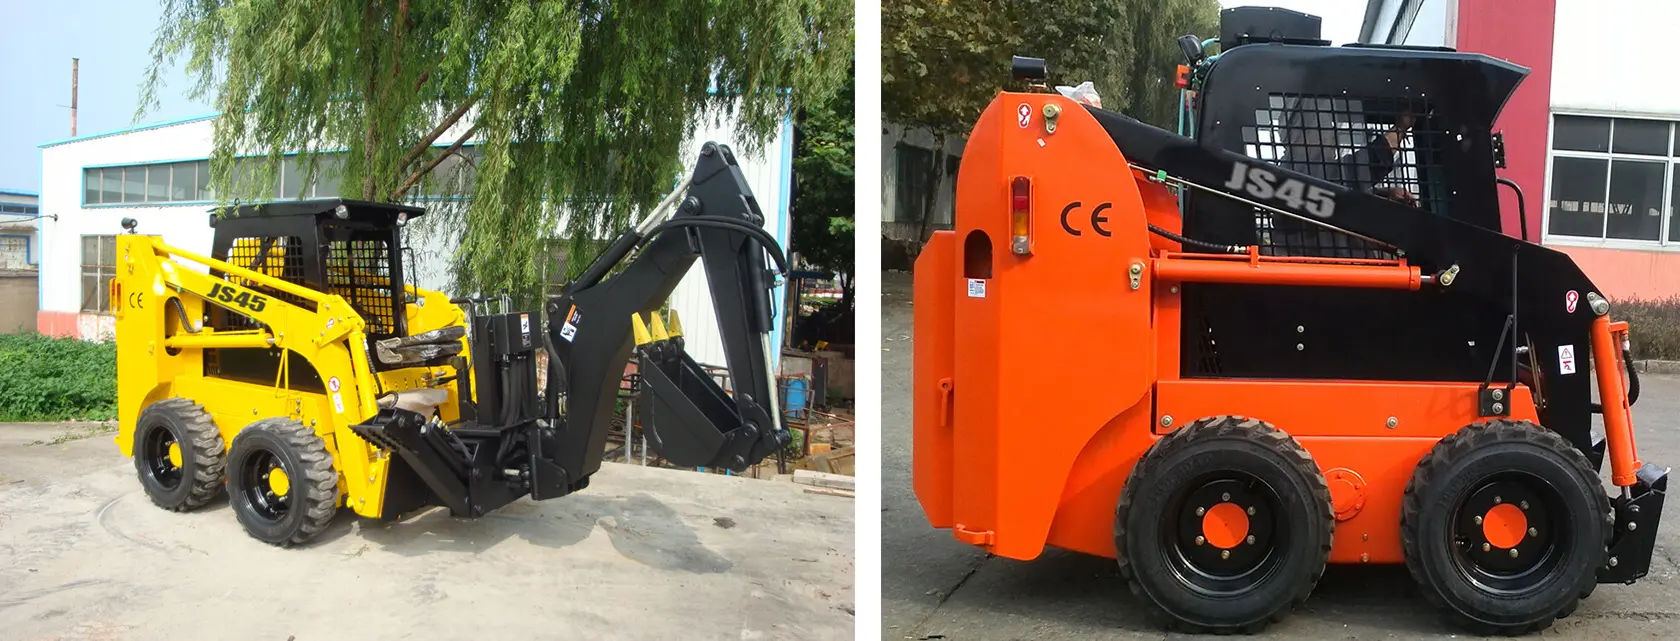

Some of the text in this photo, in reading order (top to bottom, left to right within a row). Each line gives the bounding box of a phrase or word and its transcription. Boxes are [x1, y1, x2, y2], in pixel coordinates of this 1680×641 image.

[1226, 162, 1336, 218] JS45
[1060, 202, 1112, 237] CE
[129, 292, 144, 309] CE
[206, 283, 268, 312] JS45
